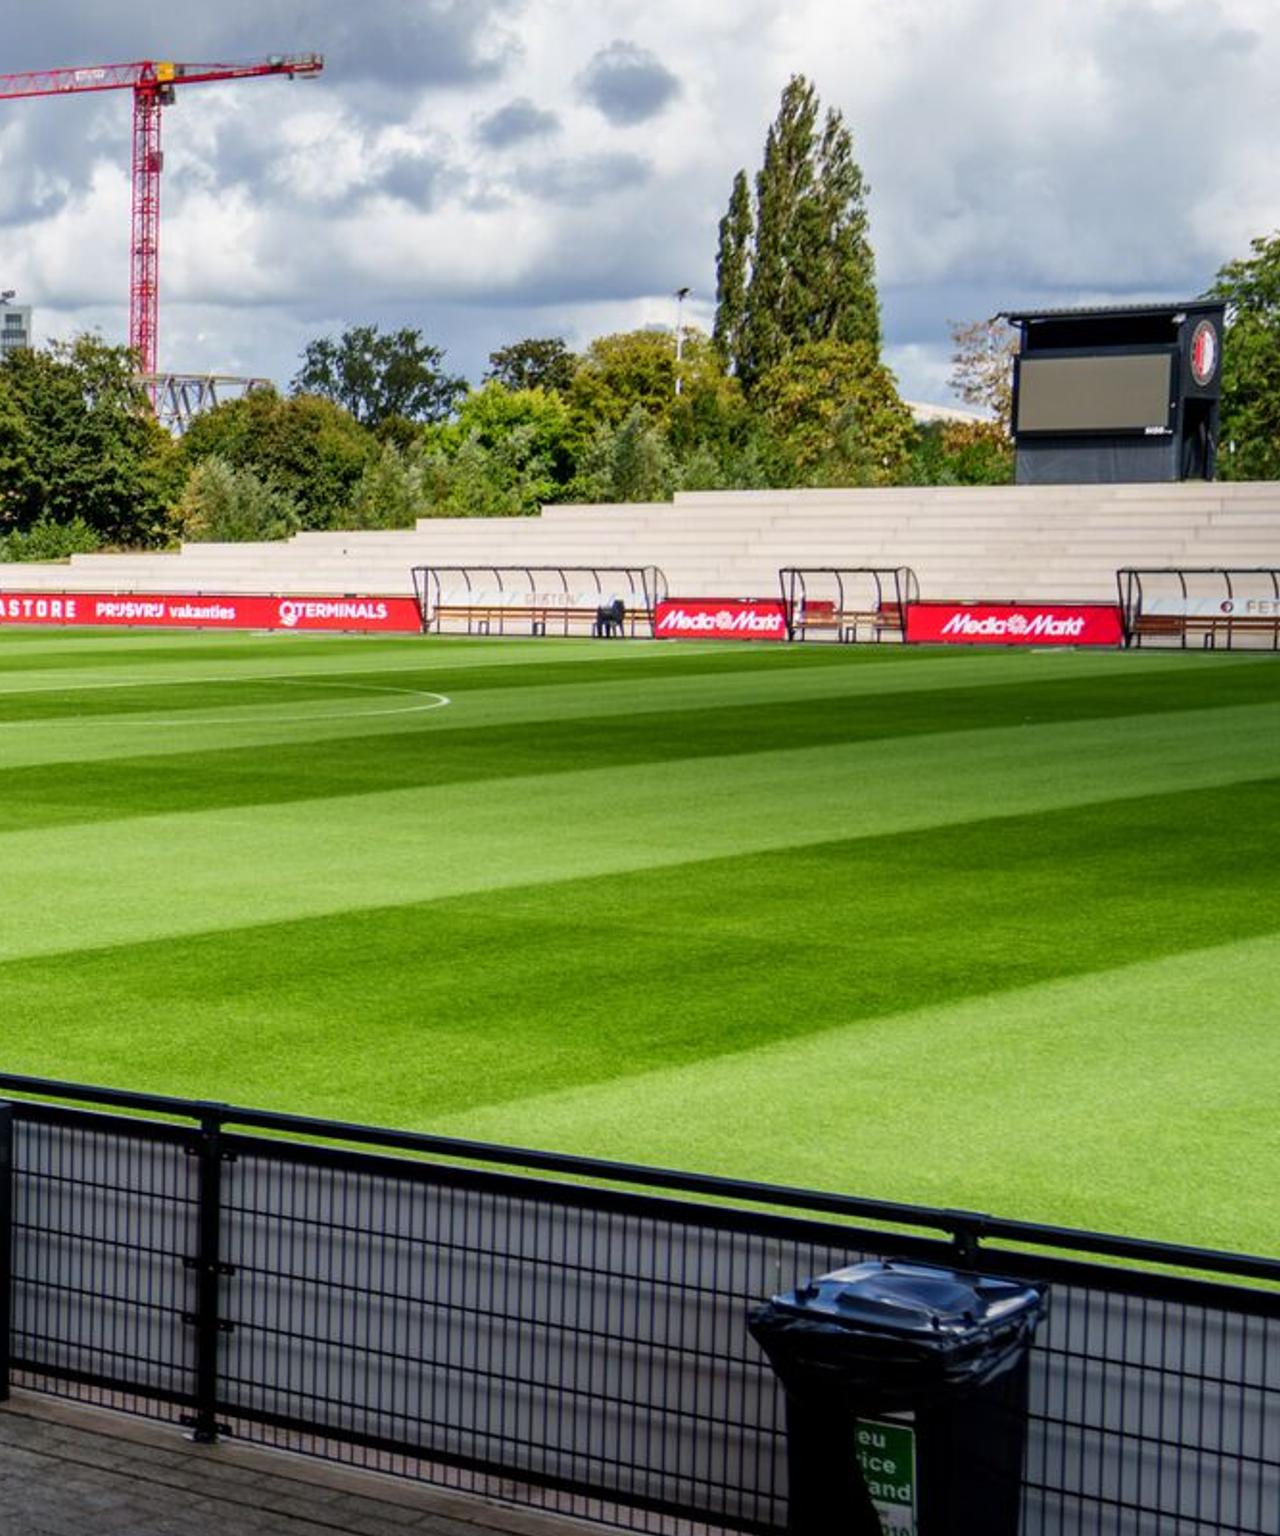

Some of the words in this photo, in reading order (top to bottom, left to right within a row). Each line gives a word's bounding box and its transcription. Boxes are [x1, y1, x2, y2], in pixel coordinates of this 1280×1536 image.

[169, 604, 236, 621] vakanties
[658, 610, 716, 630] Media
[730, 611, 784, 631] Markt
[941, 613, 1010, 635] Media
[1023, 614, 1086, 636] Markt
